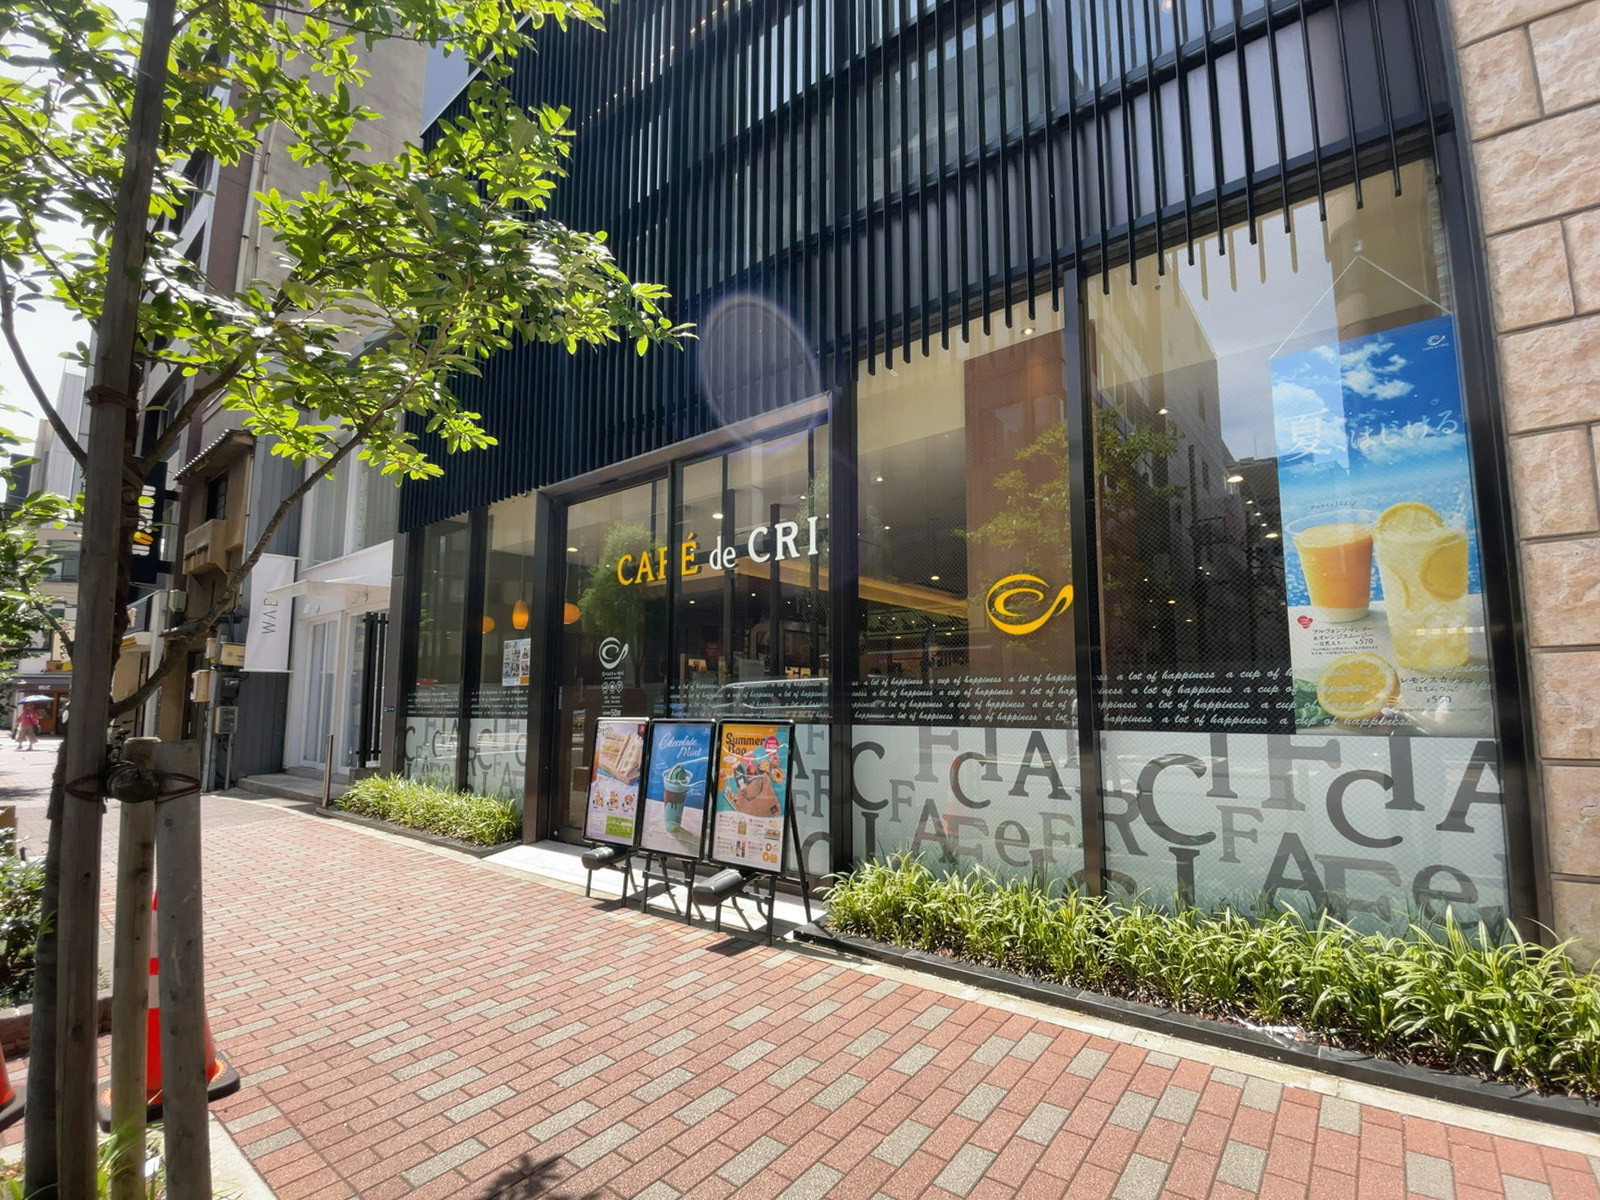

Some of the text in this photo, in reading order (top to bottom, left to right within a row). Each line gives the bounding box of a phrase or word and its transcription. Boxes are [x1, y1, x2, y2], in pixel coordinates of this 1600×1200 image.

[709, 535, 736, 571] de
[748, 516, 819, 564] CRI
[890, 677, 923, 686] happiness
[937, 676, 950, 685] cup
[953, 676, 961, 686] of
[964, 675, 1002, 685] happiness
[1019, 674, 1030, 683] lot
[1033, 674, 1042, 685] of
[1128, 671, 1143, 680] lot
[1146, 670, 1158, 683] of
[1161, 670, 1216, 682] happiness
[1240, 669, 1262, 680] cup
[1266, 667, 1280, 680] of
[900, 688, 933, 697] happiness
[947, 689, 961, 697] cup
[963, 688, 973, 698] of
[974, 687, 1013, 697] happiness
[1030, 686, 1042, 695] lot
[1045, 686, 1055, 697] of
[1143, 685, 1158, 694] lot
[1161, 684, 1174, 697] of
[1177, 684, 1233, 696] happiness
[1243, 686, 1252, 694] a
[1257, 684, 1280, 695] cup
[909, 699, 943, 709] happiness
[957, 700, 971, 709] cup
[974, 699, 983, 710] of
[985, 699, 1025, 709] happiness
[1042, 699, 1054, 708] lot
[1057, 699, 1068, 710] of
[1158, 699, 1174, 709] lot
[1177, 699, 1190, 711] of
[1193, 699, 1250, 711] happiness
[1275, 700, 1298, 711] cup
[918, 711, 954, 721] happiness
[968, 713, 982, 721] cup
[984, 712, 994, 722] of
[997, 711, 1038, 722] happiness
[1055, 713, 1068, 721] lot
[1103, 713, 1153, 724] happiness
[1174, 714, 1189, 724] lot
[1193, 714, 1206, 727] of
[1210, 713, 1269, 726] happiness
[1279, 717, 1289, 725] a
[1295, 717, 1319, 727] cup
[1323, 716, 1338, 728] of
[658, 731, 699, 750] Chocolate
[725, 731, 766, 746] Summer
[676, 746, 702, 759] Mint
[1008, 730, 1072, 800] A
[950, 751, 991, 810] C
[889, 779, 916, 823] F
[1136, 753, 1217, 847] C
[1326, 769, 1403, 848] C
[1216, 805, 1264, 864] F
[994, 820, 1031, 868] e
